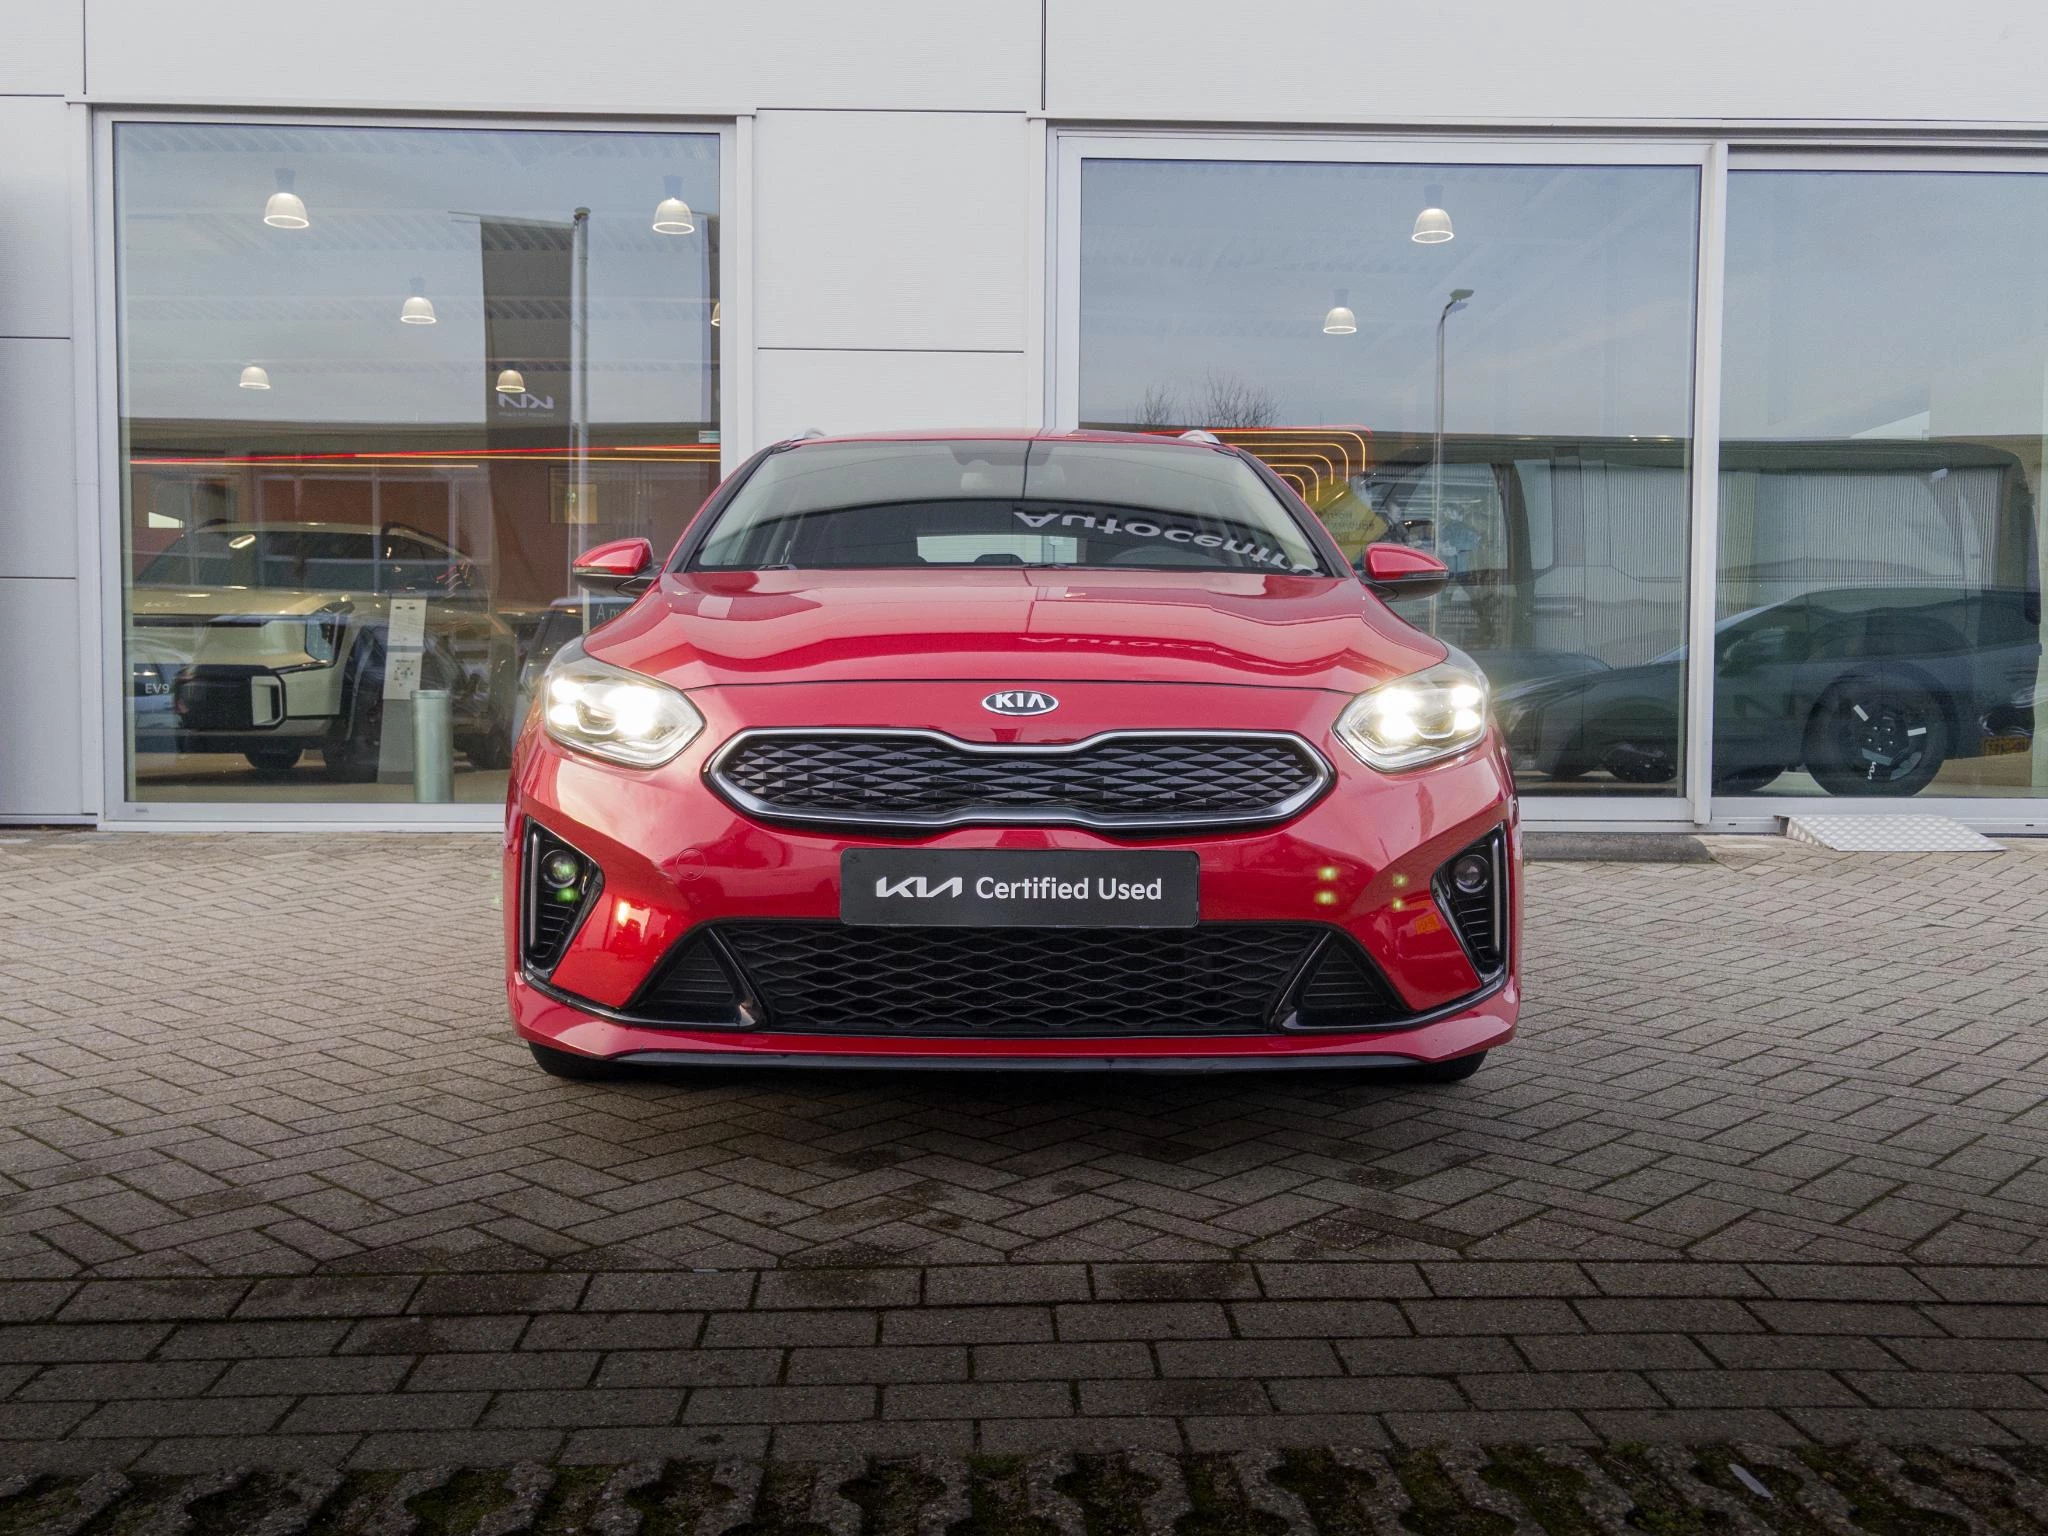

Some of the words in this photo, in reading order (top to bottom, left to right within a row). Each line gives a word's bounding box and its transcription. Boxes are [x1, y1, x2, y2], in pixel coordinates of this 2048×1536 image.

[145, 683, 170, 694] EV9
[996, 692, 1047, 709] KIA
[876, 876, 963, 898] KIA
[975, 877, 1089, 900] Certified
[1098, 878, 1162, 900] Used
